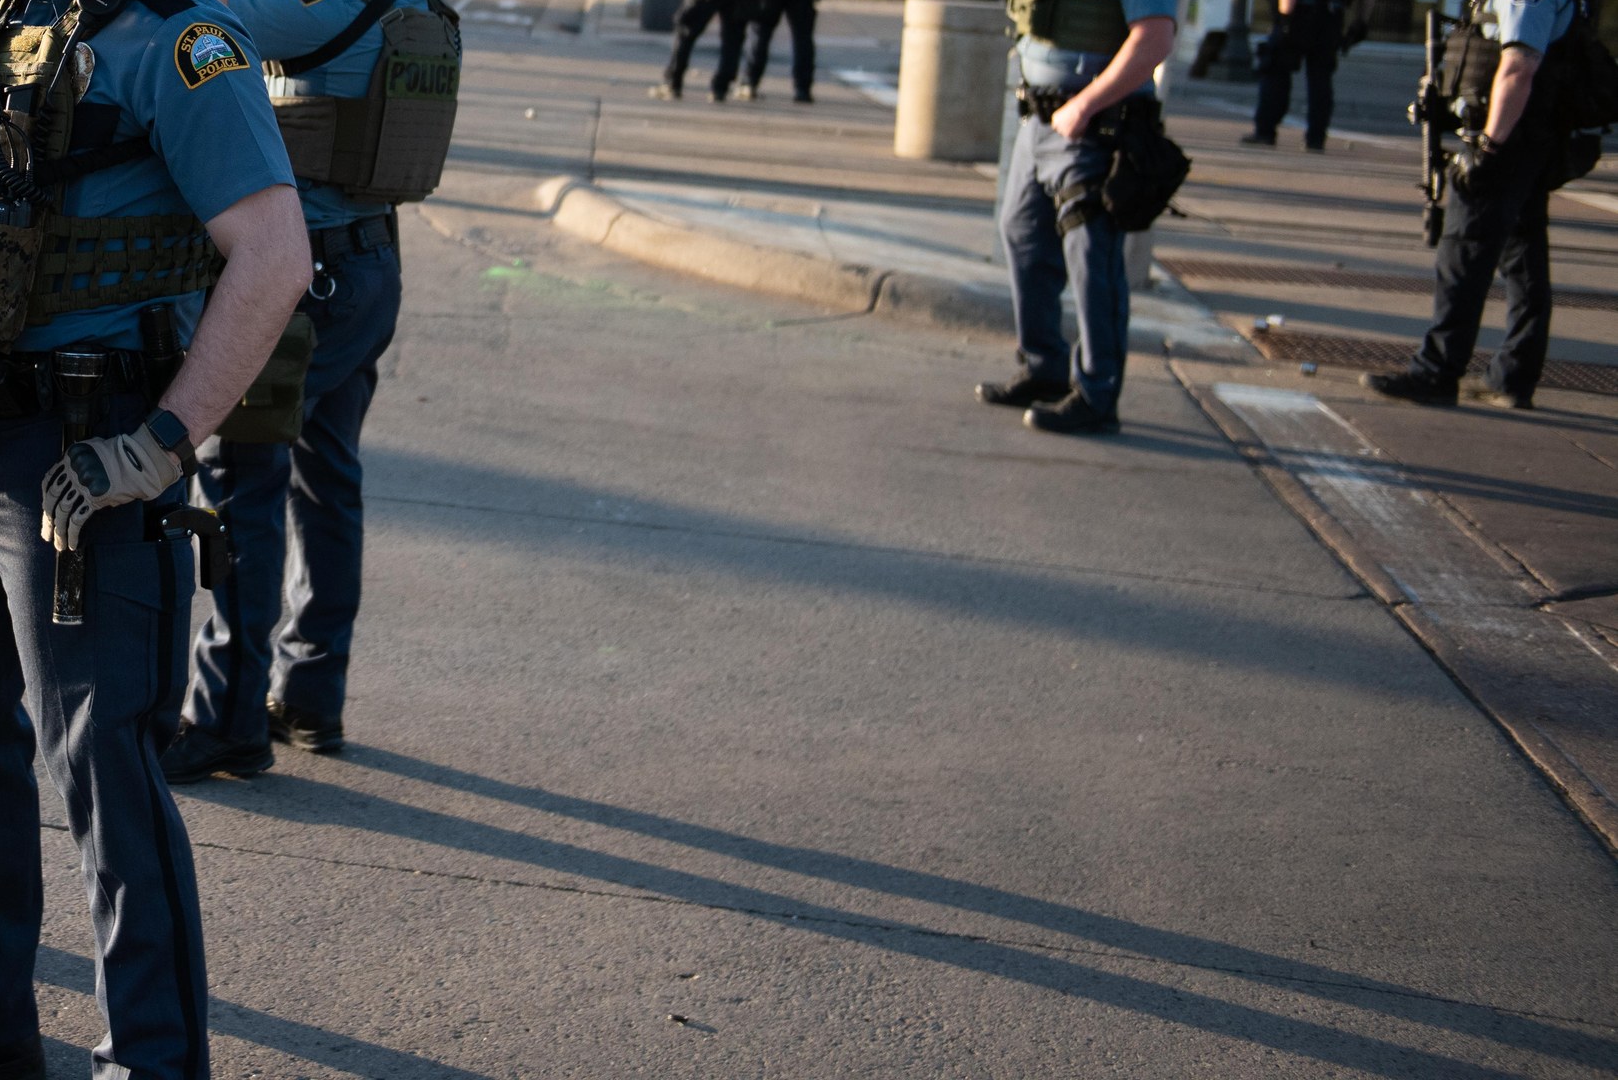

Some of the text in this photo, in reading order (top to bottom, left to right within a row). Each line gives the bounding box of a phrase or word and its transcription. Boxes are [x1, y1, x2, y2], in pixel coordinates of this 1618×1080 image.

[181, 26, 225, 53] ST. PAUL
[197, 57, 239, 80] POLICE
[390, 62, 456, 96] POLICE
